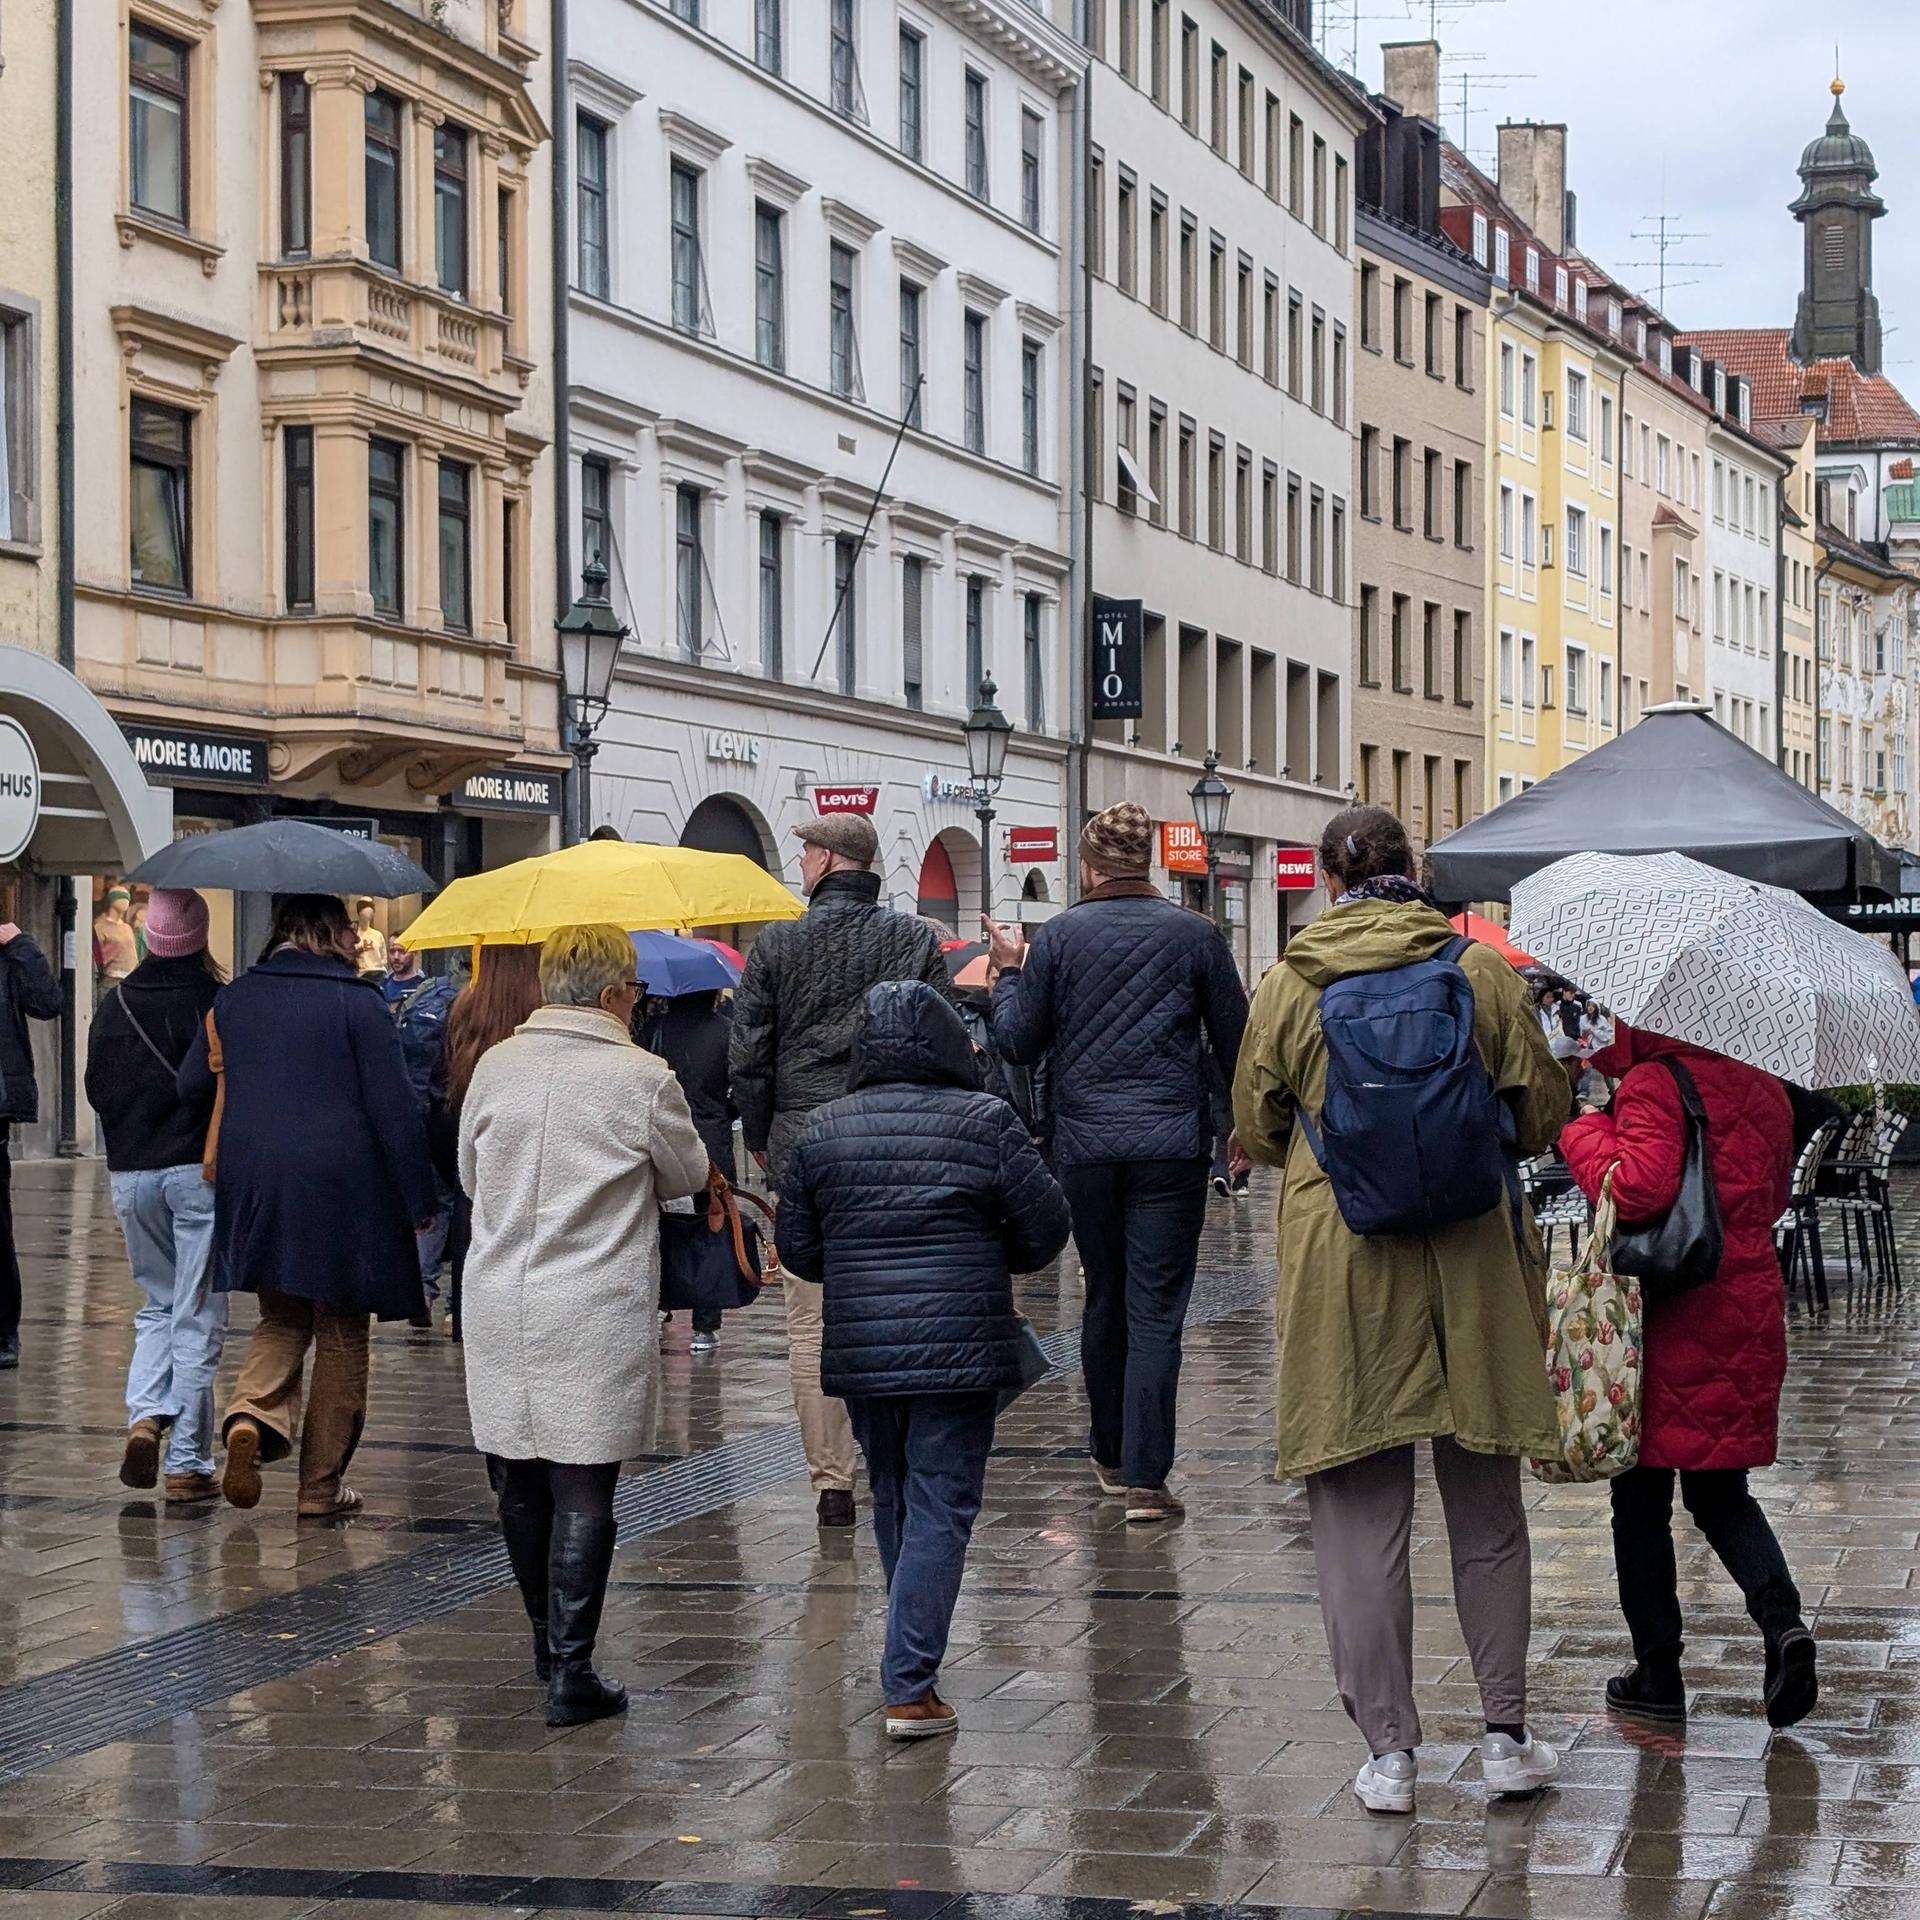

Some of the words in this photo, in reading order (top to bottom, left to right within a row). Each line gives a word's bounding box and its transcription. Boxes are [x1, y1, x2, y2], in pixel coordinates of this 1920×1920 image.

[1102, 621, 1123, 699] MIO
[135, 737, 187, 767] MORE
[189, 743, 202, 769] &
[203, 744, 252, 773] MORE
[465, 776, 503, 800] MORE
[504, 779, 513, 800] &
[514, 780, 549, 804] MORE
[1168, 826, 1202, 847] JBL
[1168, 850, 1202, 861] STORE
[1278, 863, 1313, 875] REWE
